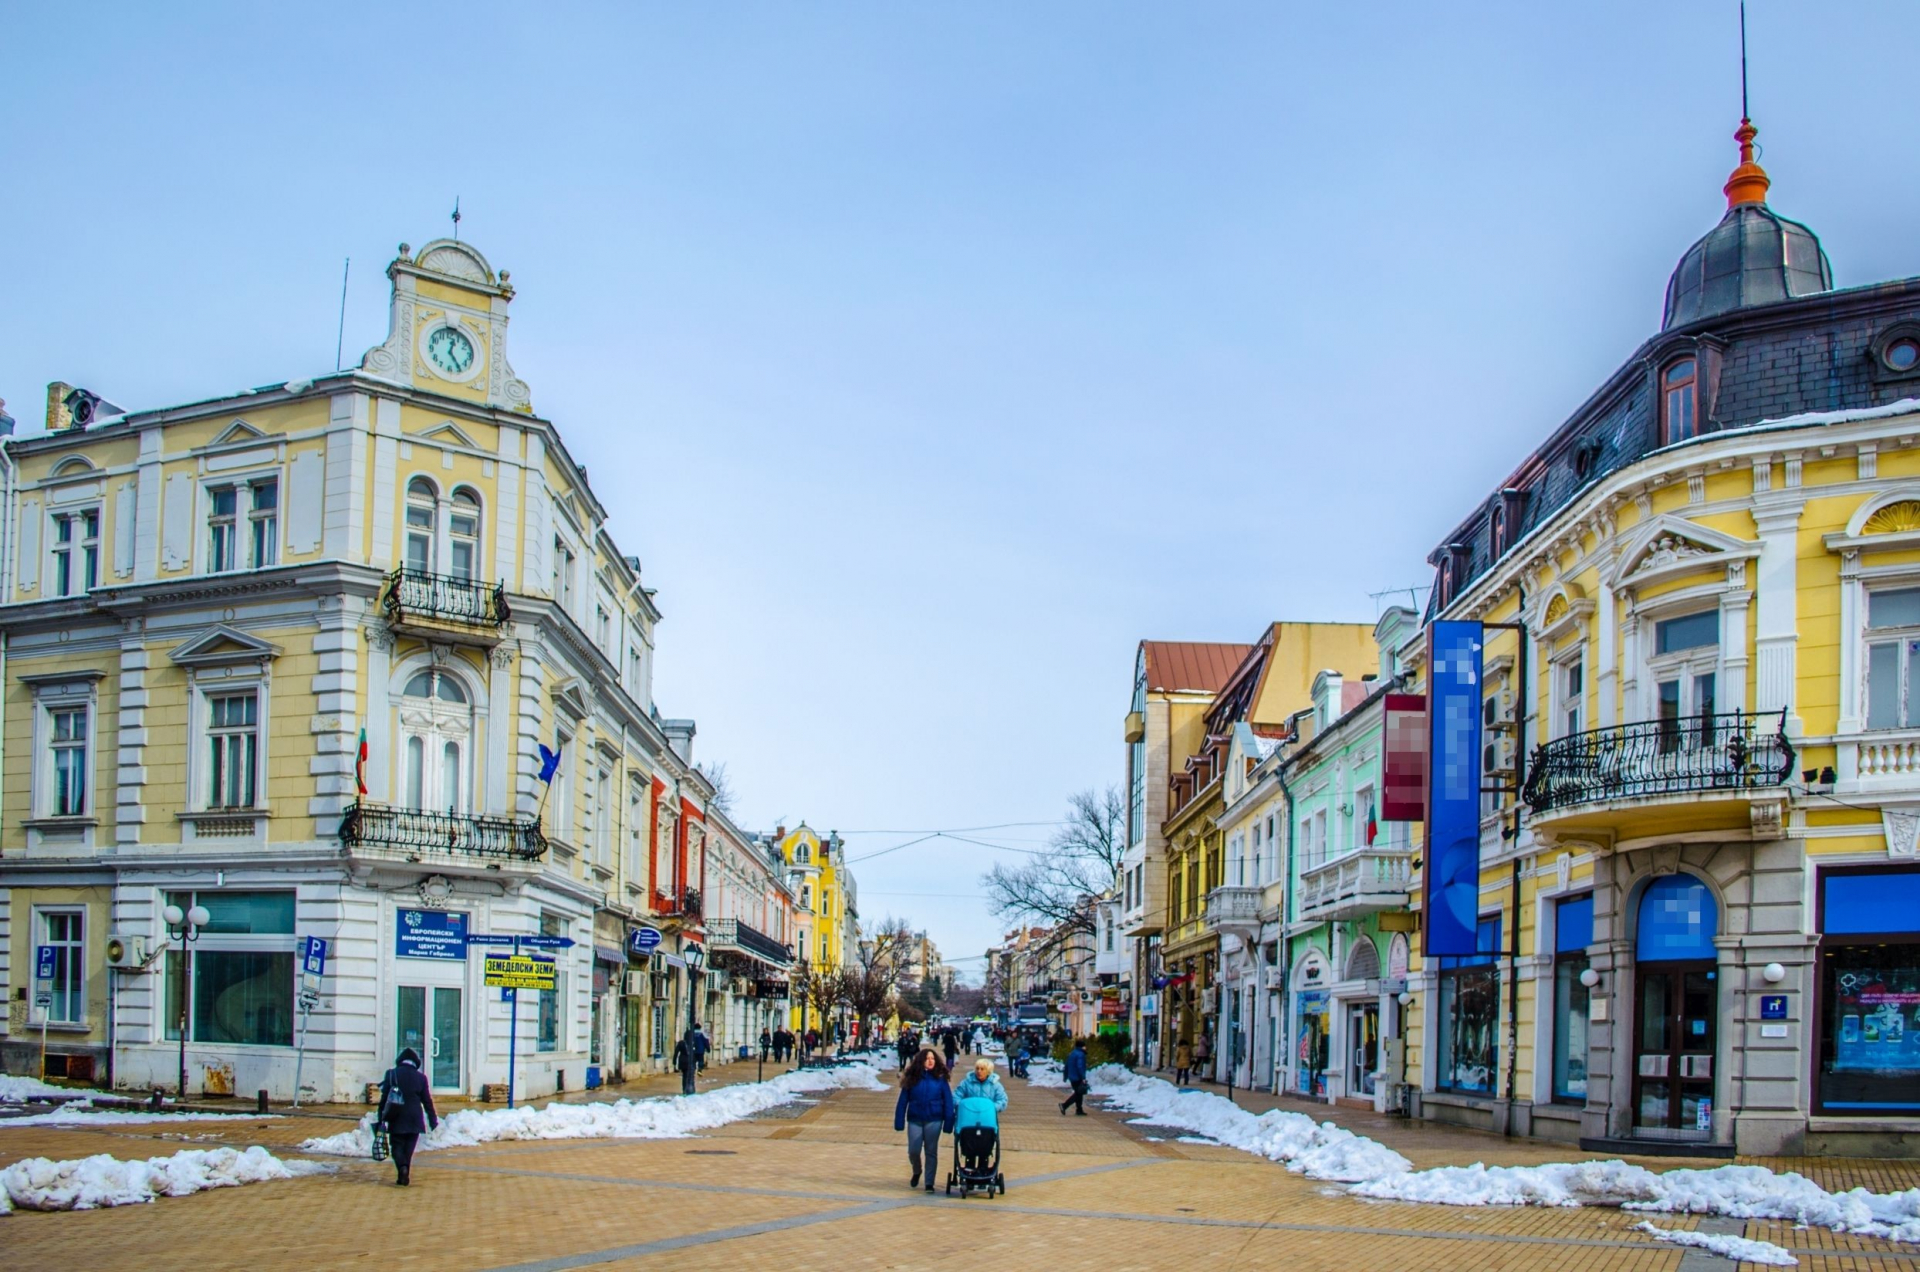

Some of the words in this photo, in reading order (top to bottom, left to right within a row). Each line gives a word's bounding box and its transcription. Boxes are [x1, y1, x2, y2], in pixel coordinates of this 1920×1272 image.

[410, 928, 454, 936] ЕВРОПЕЙСКИ
[402, 935, 462, 944] ИНФОРМАЦИОНЕН
[311, 939, 321, 955] P
[42, 948, 52, 962] P
[488, 960, 534, 973] ЗЕМЕДЕЛСКИ
[534, 963, 554, 975] ЗЕМИ
